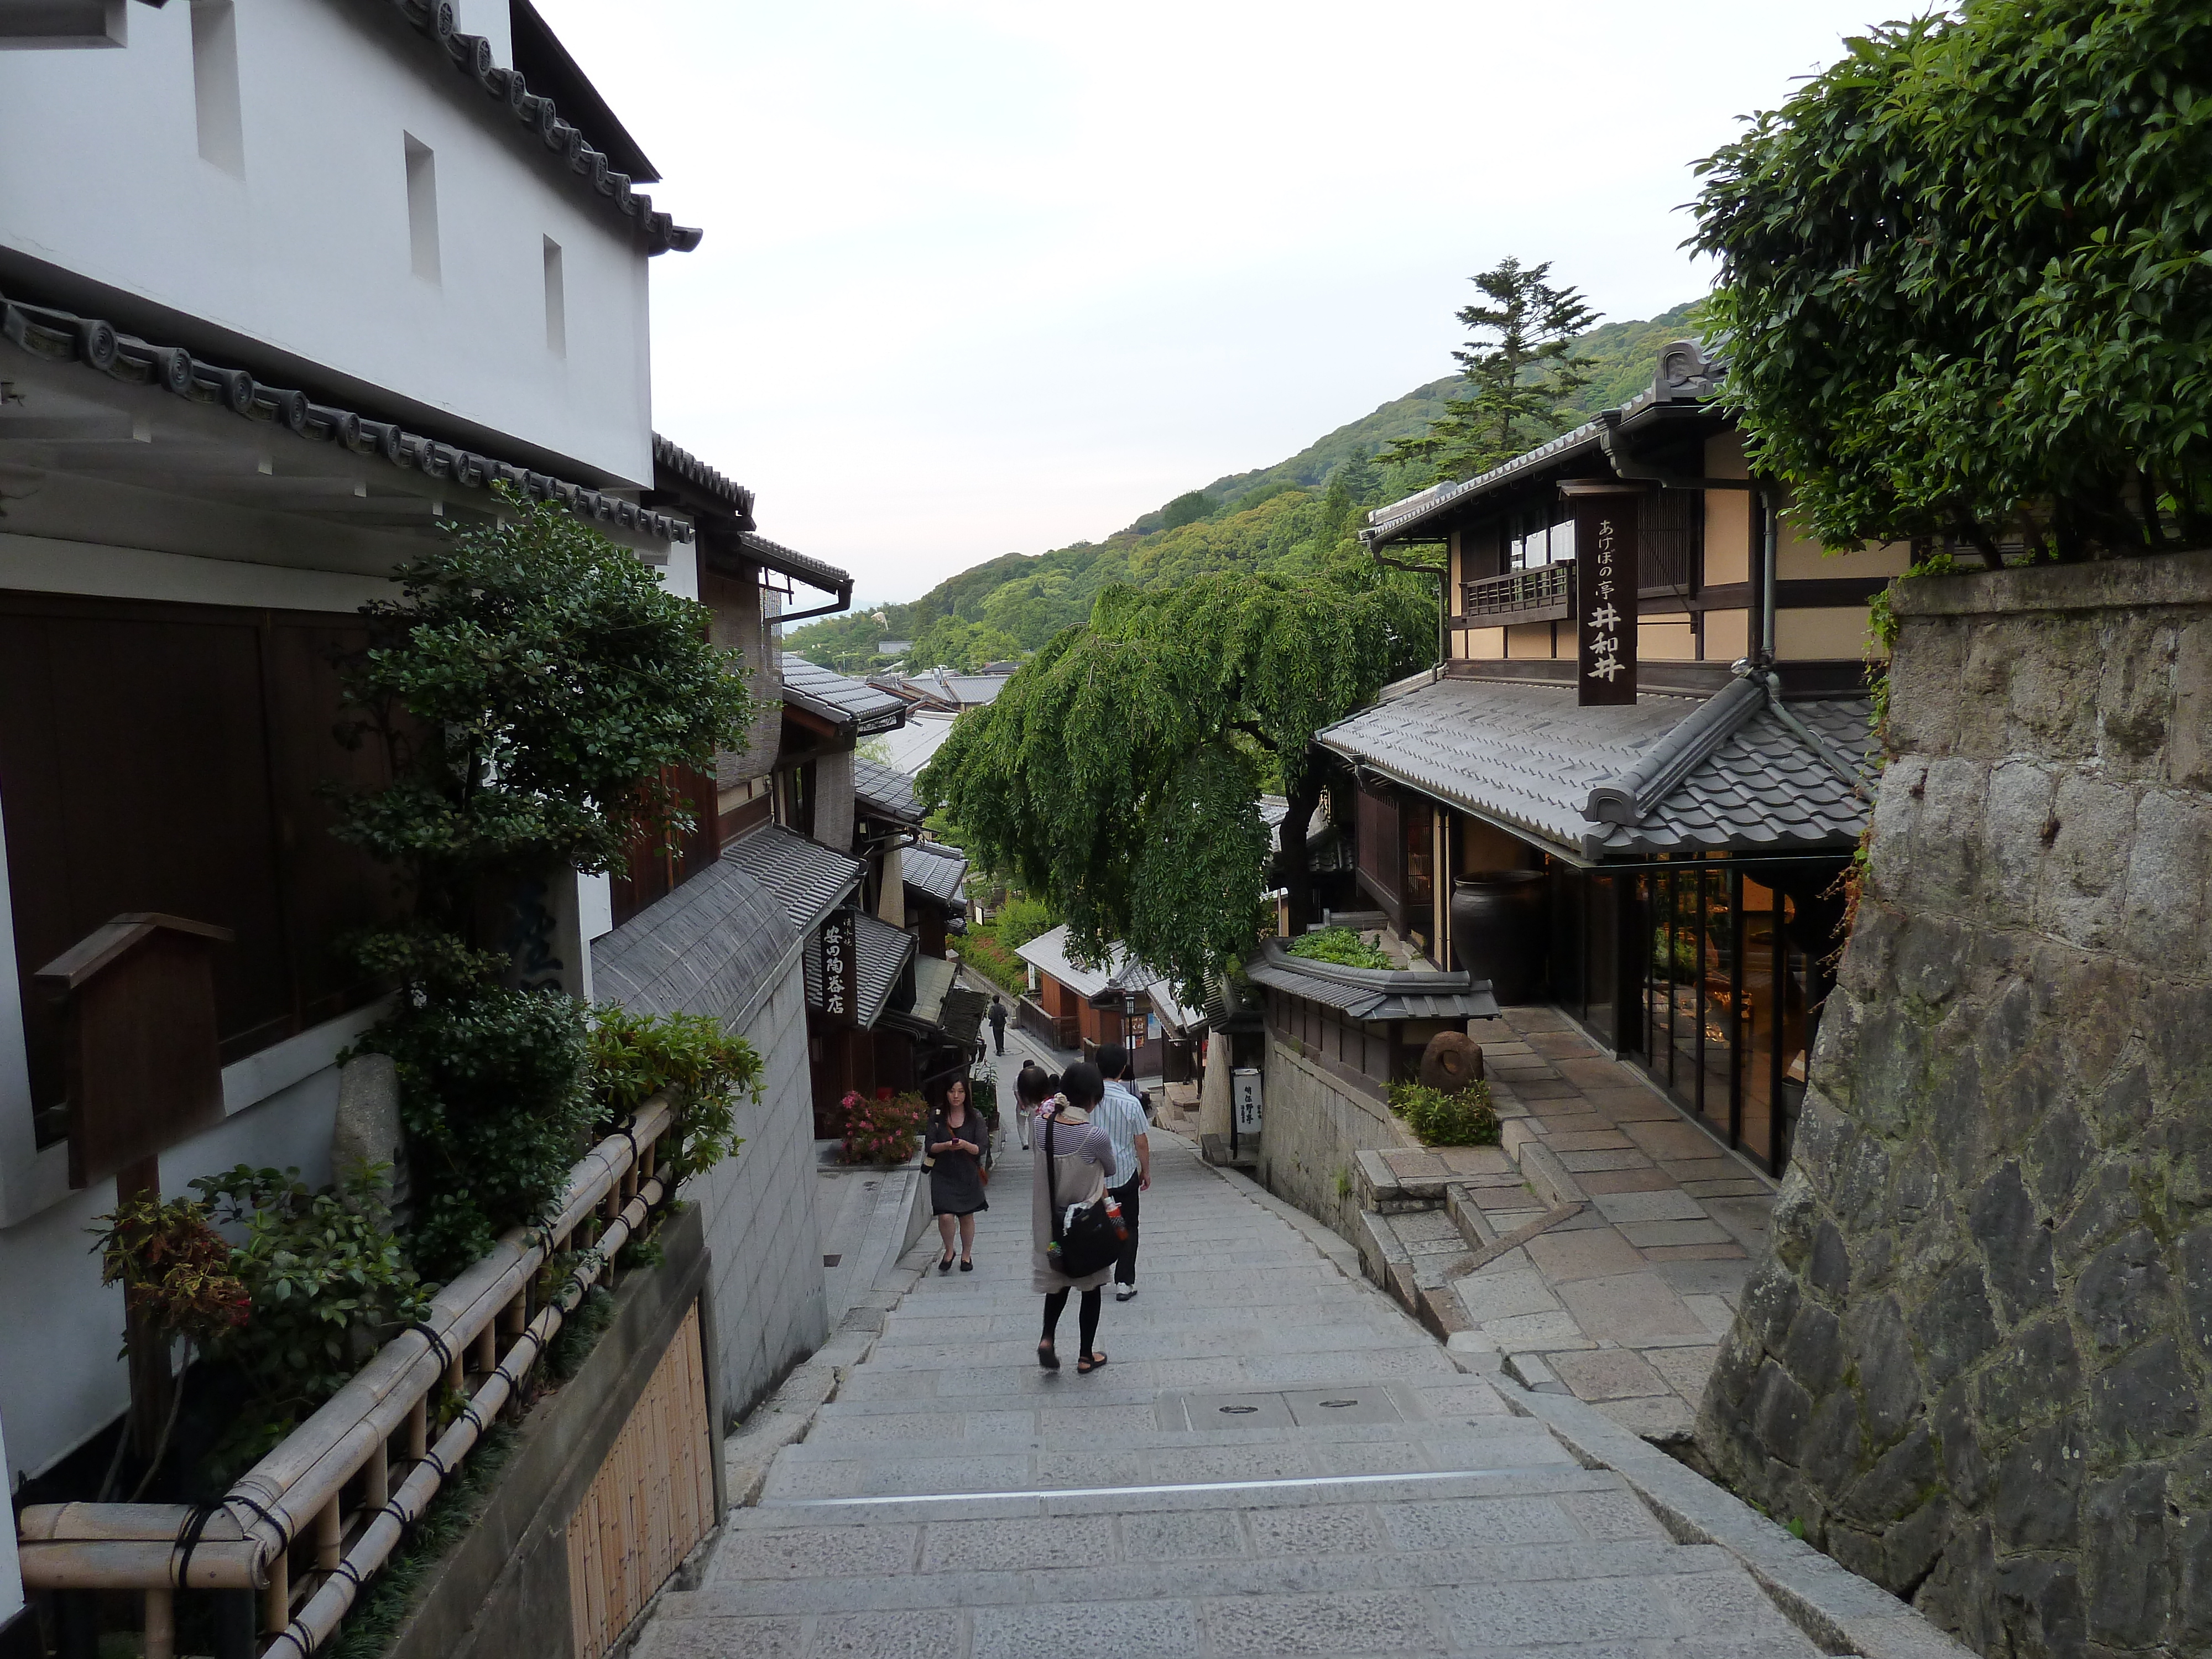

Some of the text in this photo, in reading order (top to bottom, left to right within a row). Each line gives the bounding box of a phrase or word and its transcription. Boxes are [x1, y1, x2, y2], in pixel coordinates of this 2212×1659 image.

[1587, 519, 1626, 683] あけぼの亭 井和井
[824, 926, 845, 1014] 安田陶器店
